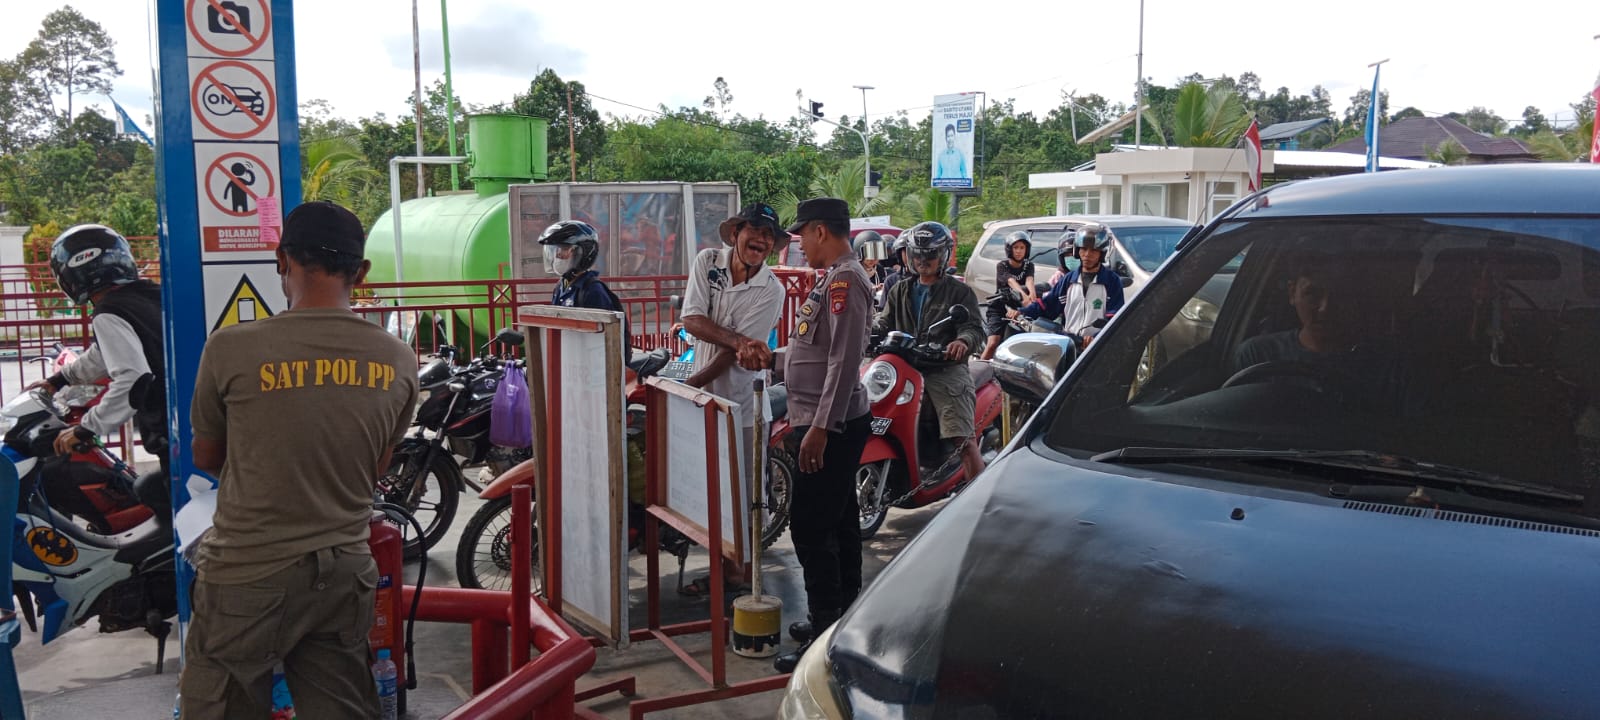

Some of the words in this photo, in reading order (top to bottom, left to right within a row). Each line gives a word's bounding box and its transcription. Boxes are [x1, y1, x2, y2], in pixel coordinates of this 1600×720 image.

[208, 94, 233, 104] ON
[218, 229, 259, 238] DILARAN
[260, 360, 308, 392] SAT
[315, 359, 361, 386] POL
[367, 361, 395, 391] PP
